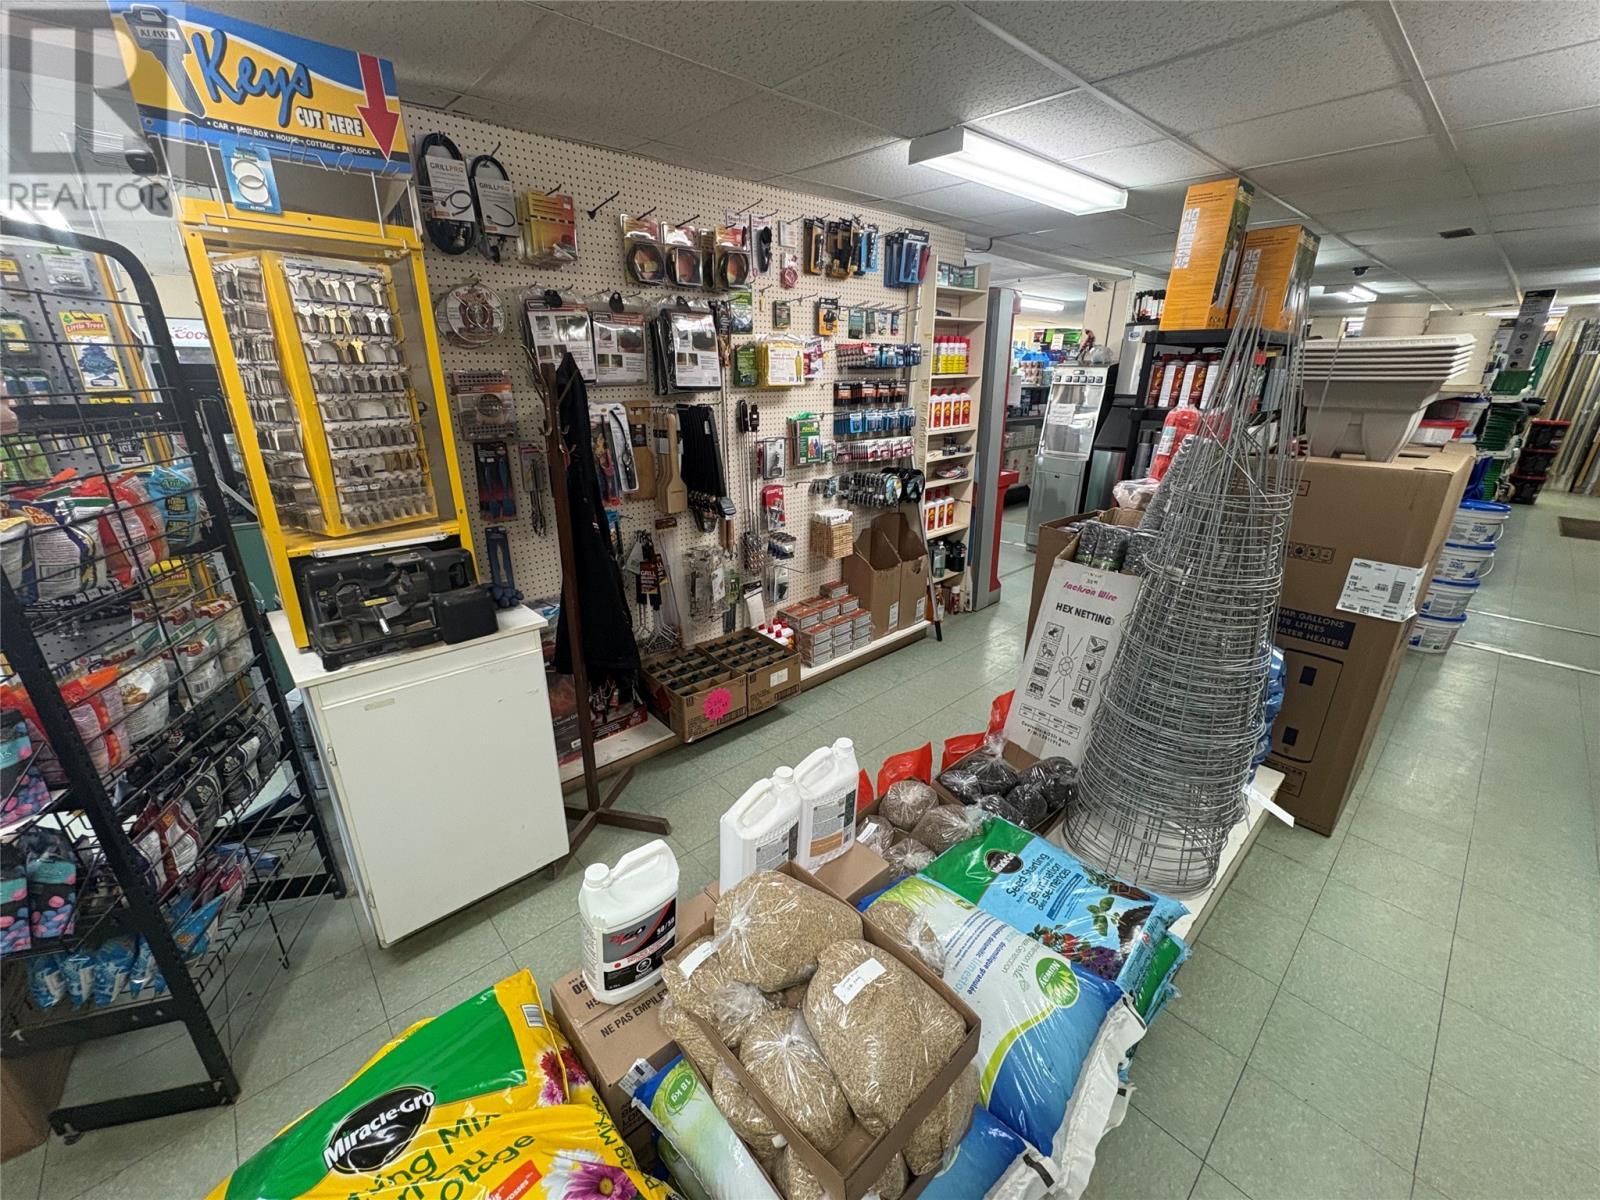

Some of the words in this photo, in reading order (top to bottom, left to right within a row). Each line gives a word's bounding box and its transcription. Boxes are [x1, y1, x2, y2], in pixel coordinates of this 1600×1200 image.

[192, 29, 312, 128] Keys
[296, 106, 323, 129] CUT
[328, 112, 364, 137] HERE
[212, 121, 229, 130] CAR
[253, 129, 269, 138] BOX
[306, 139, 335, 151] COTTAGE
[342, 145, 371, 156] PADLOCK
[1063, 581, 1097, 597] Jackson
[1097, 590, 1118, 602] Wire
[1056, 602, 1073, 614] HEX
[1075, 608, 1112, 626] NETTING
[1299, 613, 1345, 628] GALLONS
[1295, 621, 1326, 633] LITRES
[1305, 633, 1345, 648] HEATER
[1021, 853, 1050, 877] Starting
[600, 1023, 615, 1038] NE
[614, 1012, 634, 1029] PAS
[671, 1090, 683, 1104] kg
[681, 1078, 692, 1092] 18
[322, 1090, 436, 1170] Miracle-Gro
